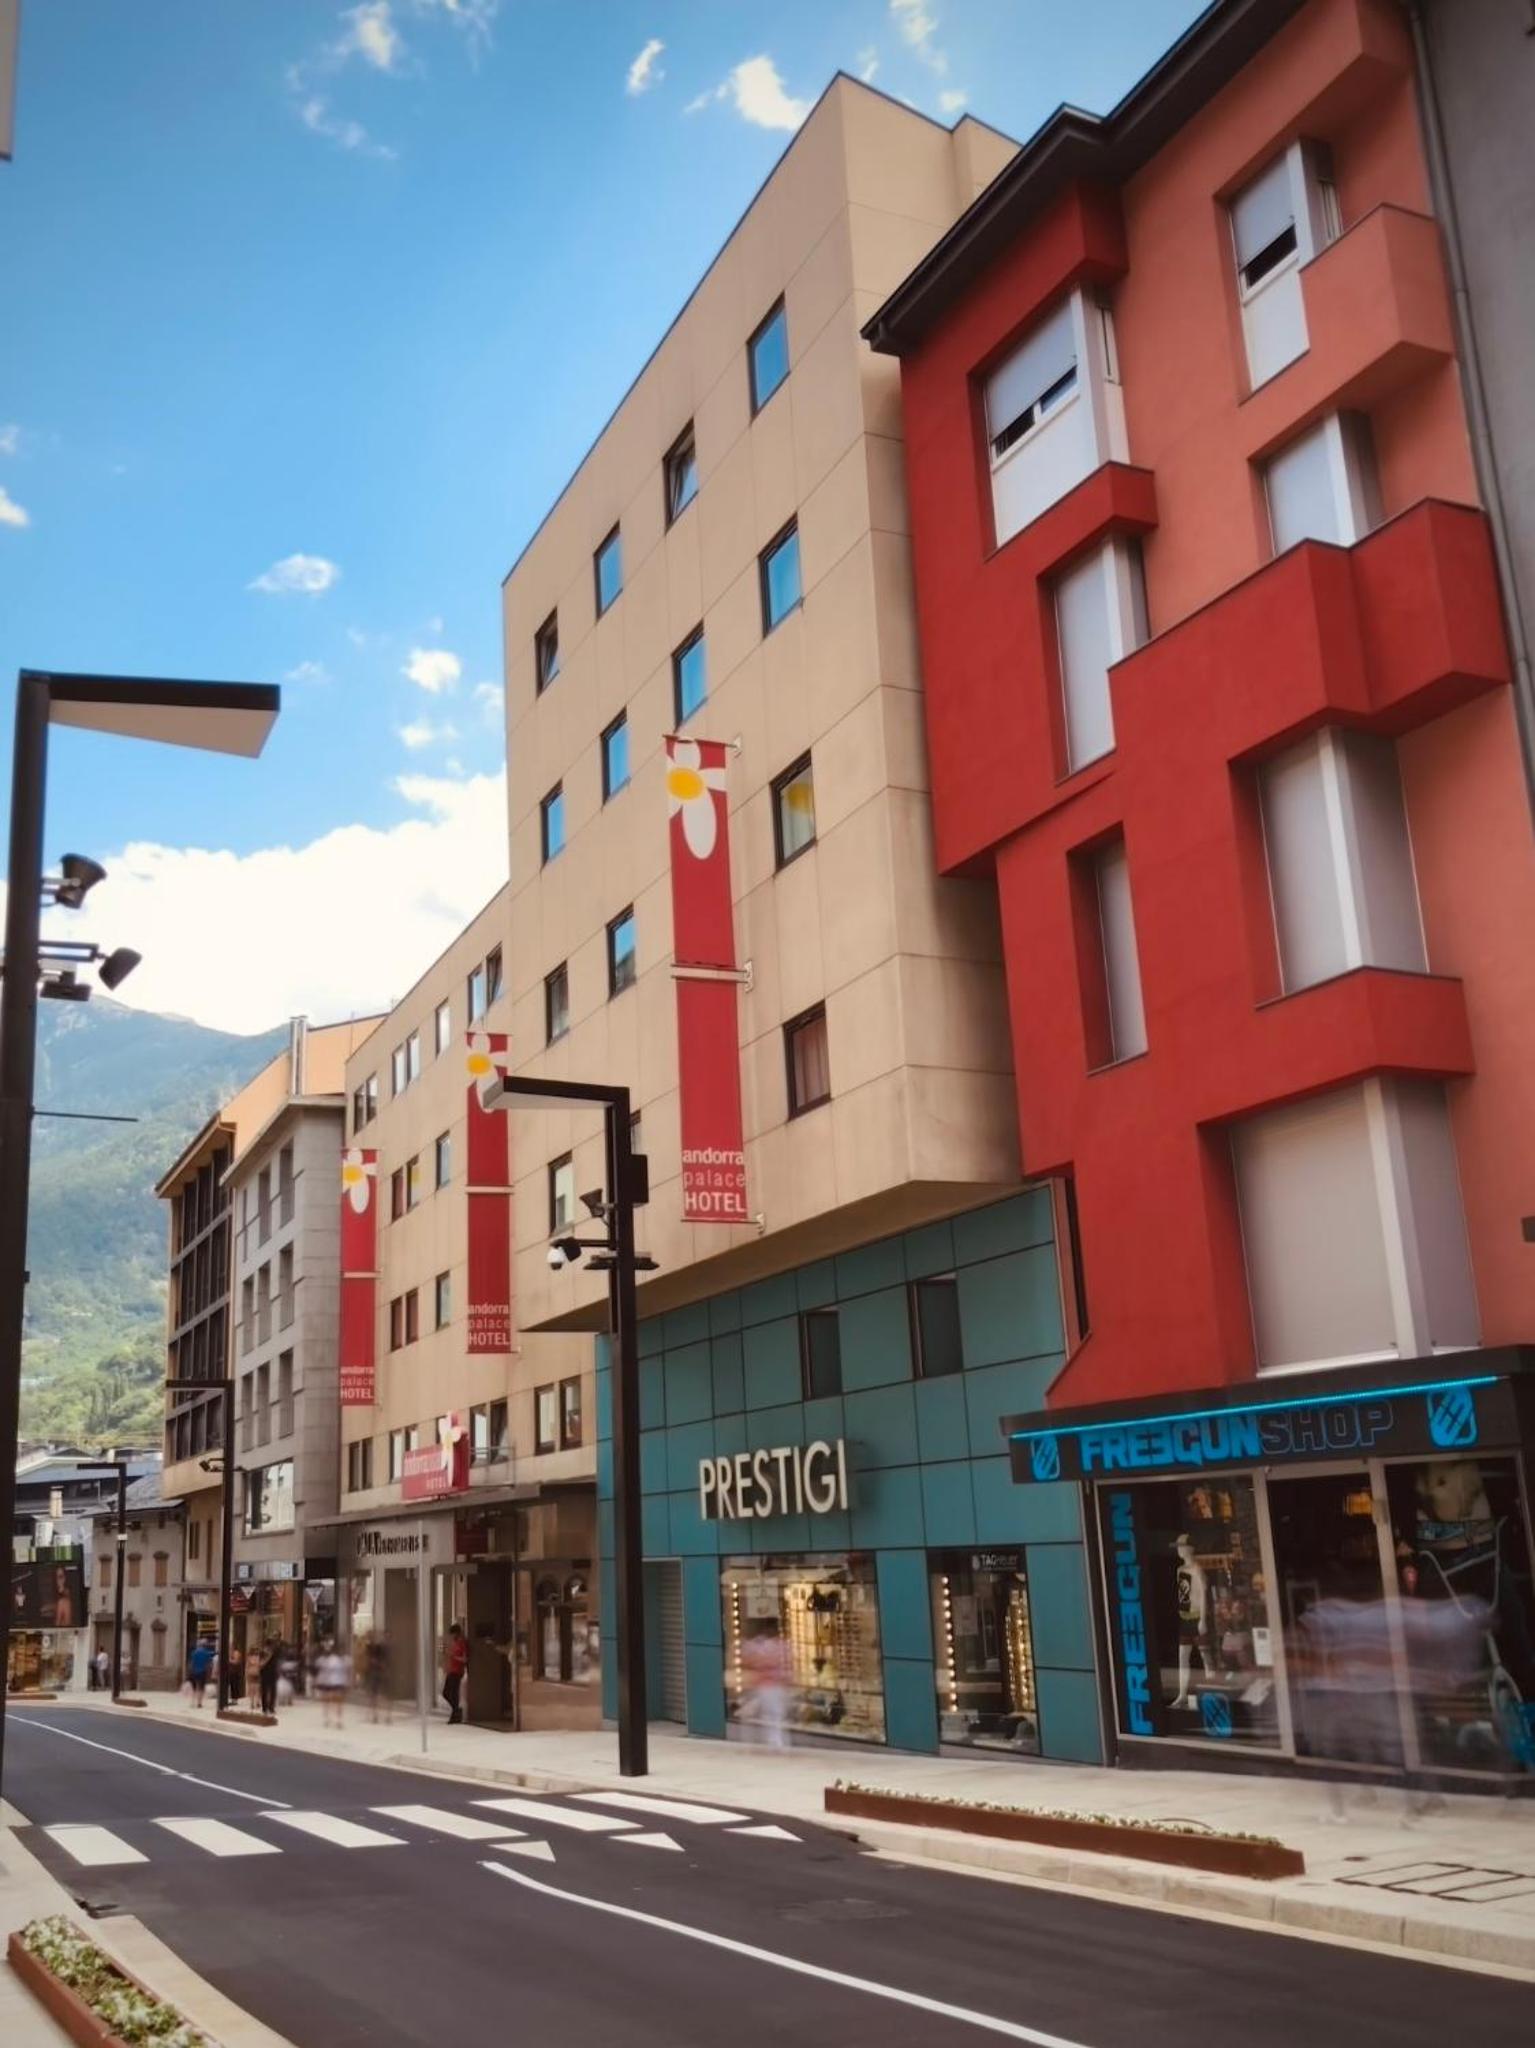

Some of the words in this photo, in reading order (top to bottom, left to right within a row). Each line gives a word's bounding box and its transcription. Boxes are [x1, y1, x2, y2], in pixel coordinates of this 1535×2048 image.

[682, 1147, 744, 1165] andorra
[683, 1169, 745, 1190] palace
[685, 1191, 746, 1213] HOTEL
[469, 1332, 510, 1346] HOTEL
[340, 1388, 374, 1399] HOTEL
[699, 1438, 848, 1520] PRESTIGI
